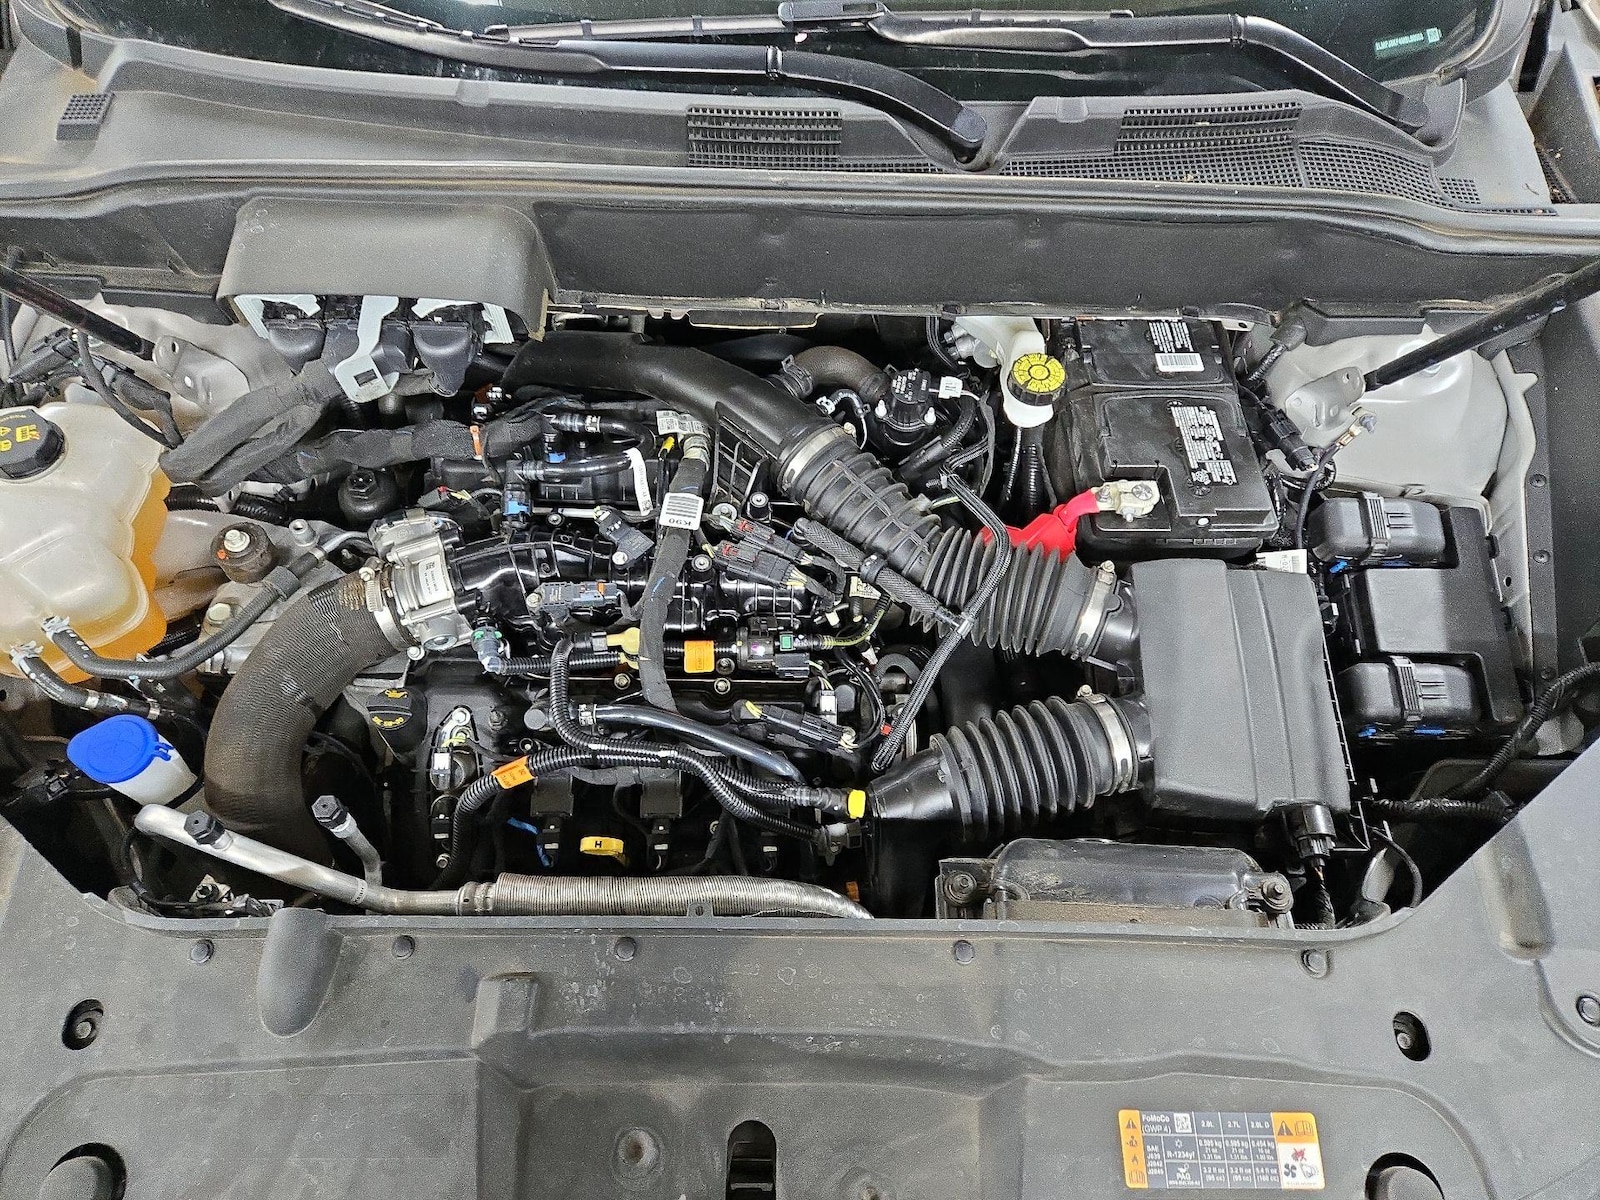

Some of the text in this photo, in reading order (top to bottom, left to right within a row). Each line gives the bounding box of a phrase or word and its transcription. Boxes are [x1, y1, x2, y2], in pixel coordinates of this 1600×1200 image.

[594, 840, 602, 848] H
[1142, 1114, 1170, 1122] FoMoCo
[1142, 1124, 1171, 1134] (GWP 4)
